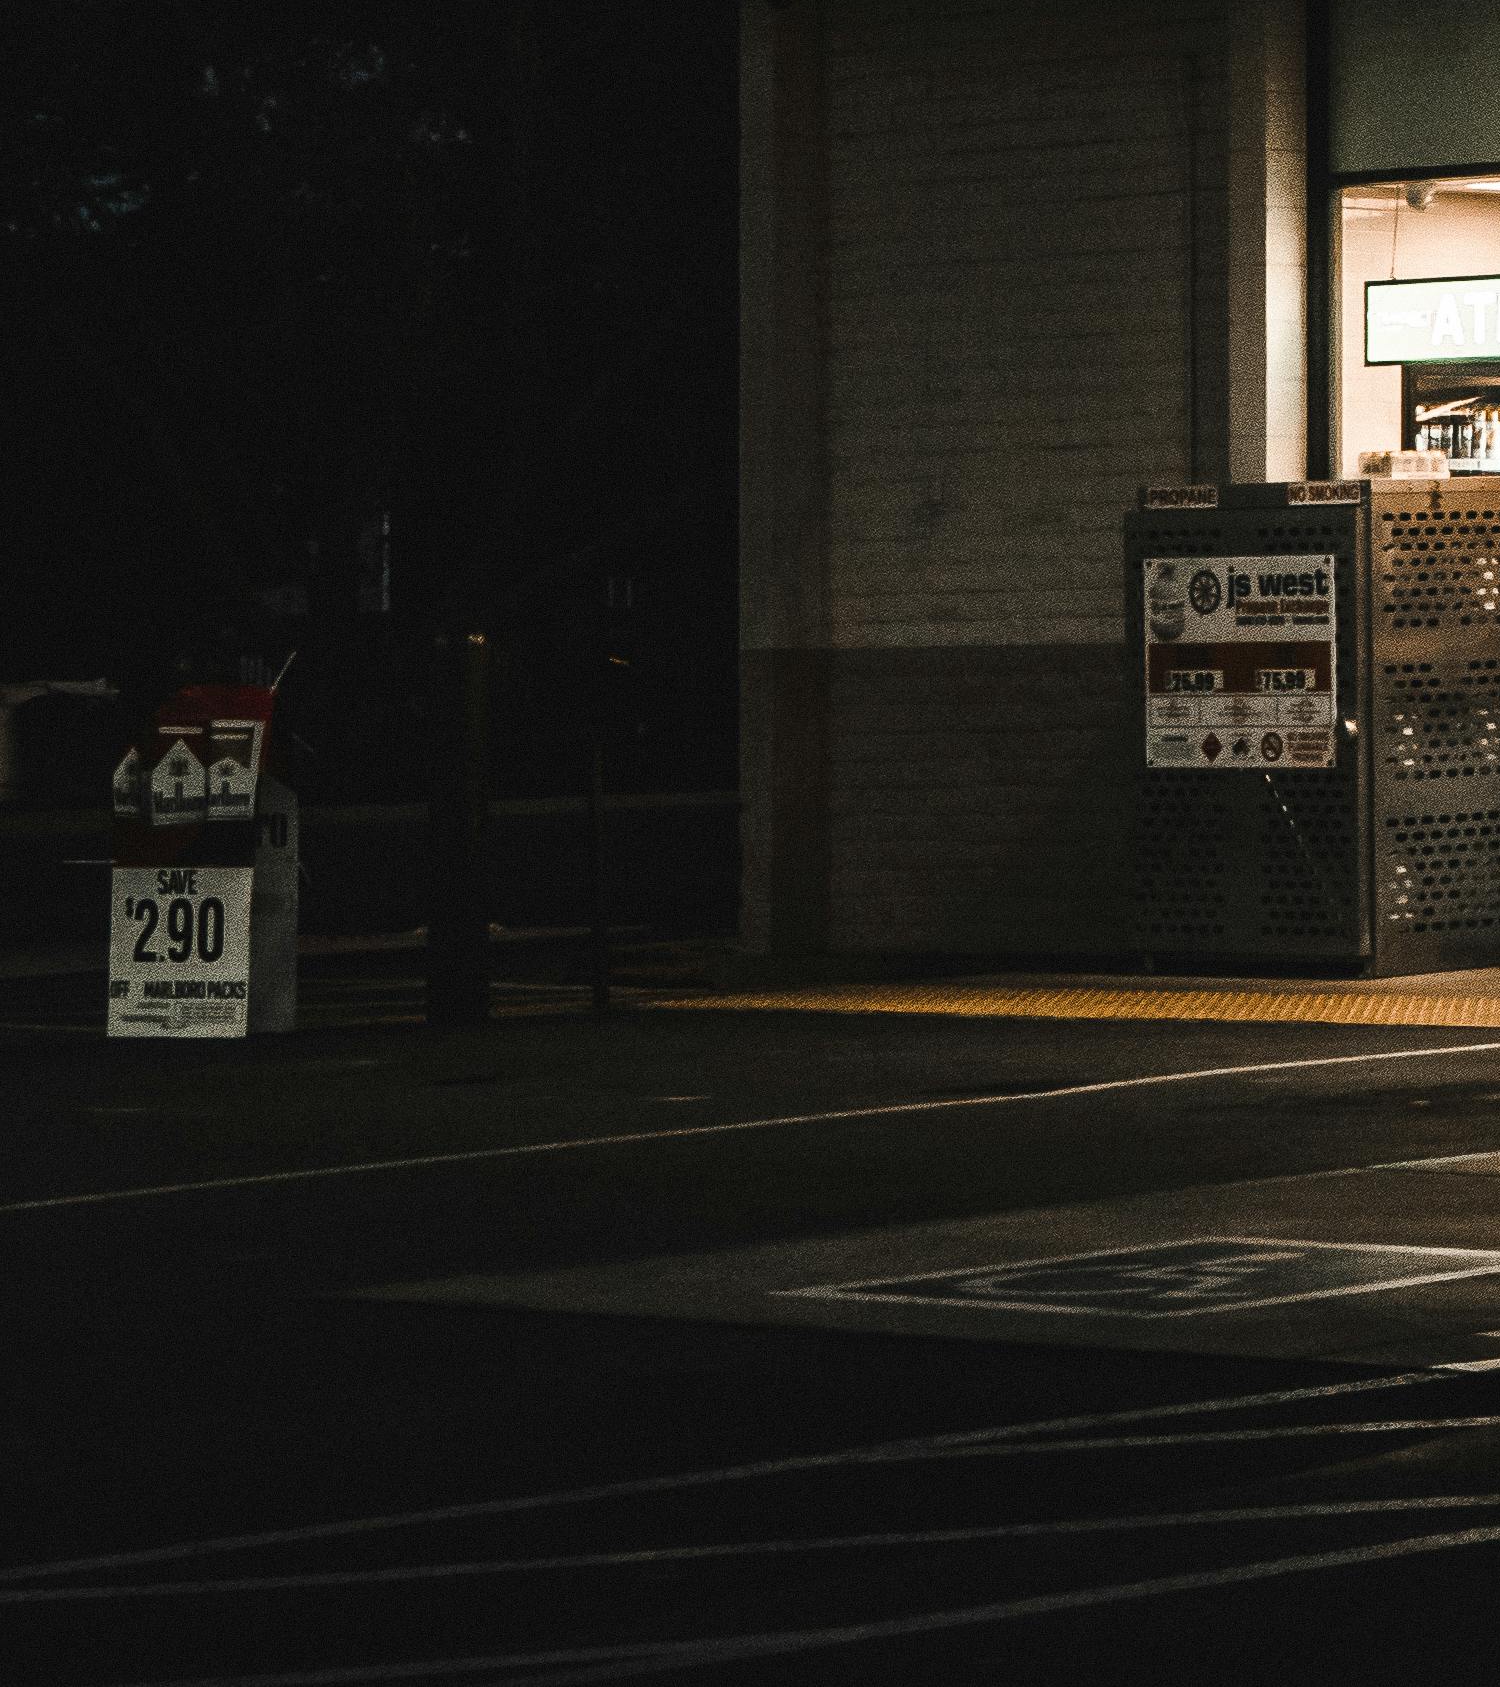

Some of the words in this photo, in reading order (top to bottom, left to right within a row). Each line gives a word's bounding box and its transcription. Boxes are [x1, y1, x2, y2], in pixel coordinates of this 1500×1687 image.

[1290, 486, 1306, 502] NO
[1308, 484, 1359, 501] SMOKING
[1227, 565, 1251, 609] js
[1259, 569, 1329, 596] west
[157, 870, 198, 895] SAVE
[125, 896, 224, 963] $2.90
[110, 981, 130, 999] OFF
[144, 981, 205, 999] MARLBORO
[207, 981, 246, 1000] PACKS
